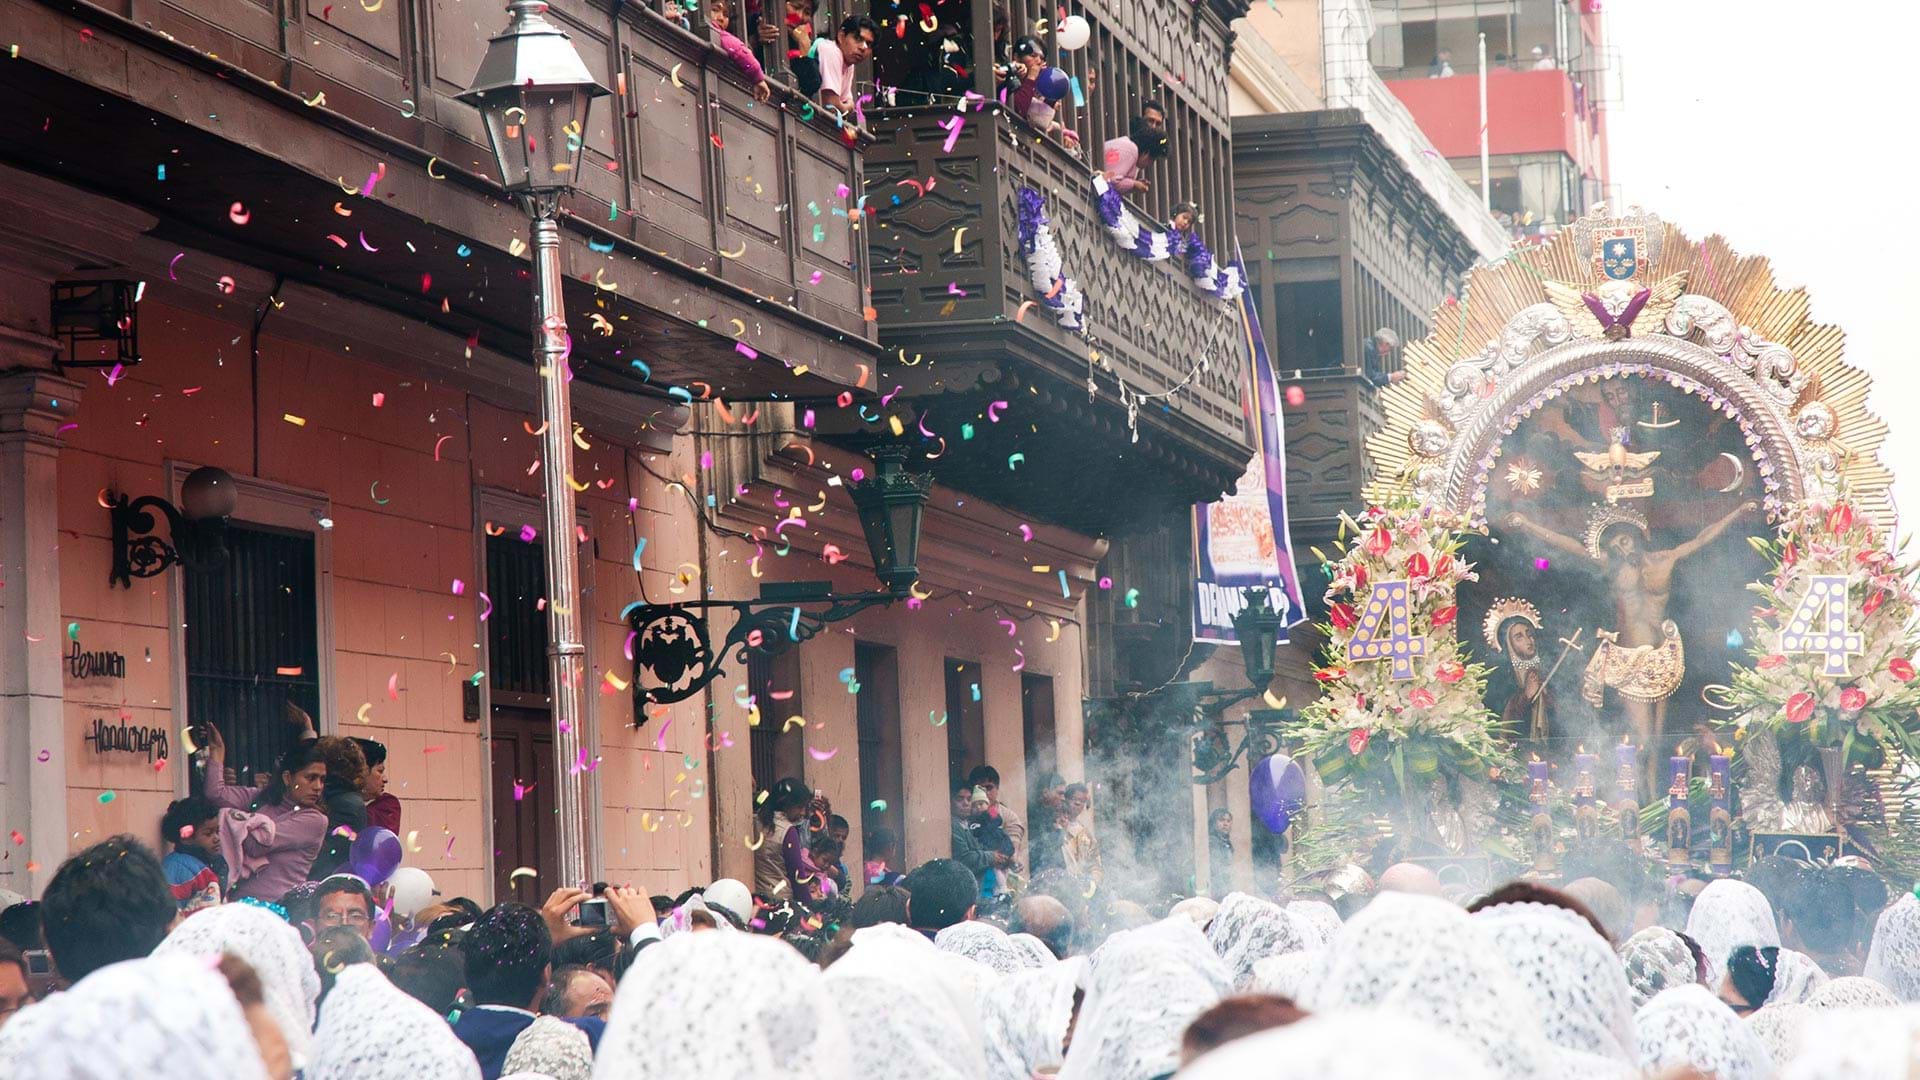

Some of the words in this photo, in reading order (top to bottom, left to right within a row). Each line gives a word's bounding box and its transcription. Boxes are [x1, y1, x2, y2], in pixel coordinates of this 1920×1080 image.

[1346, 579, 1427, 681] 4
[1781, 575, 1864, 677] 4
[85, 718, 168, 764] Handicrafts
